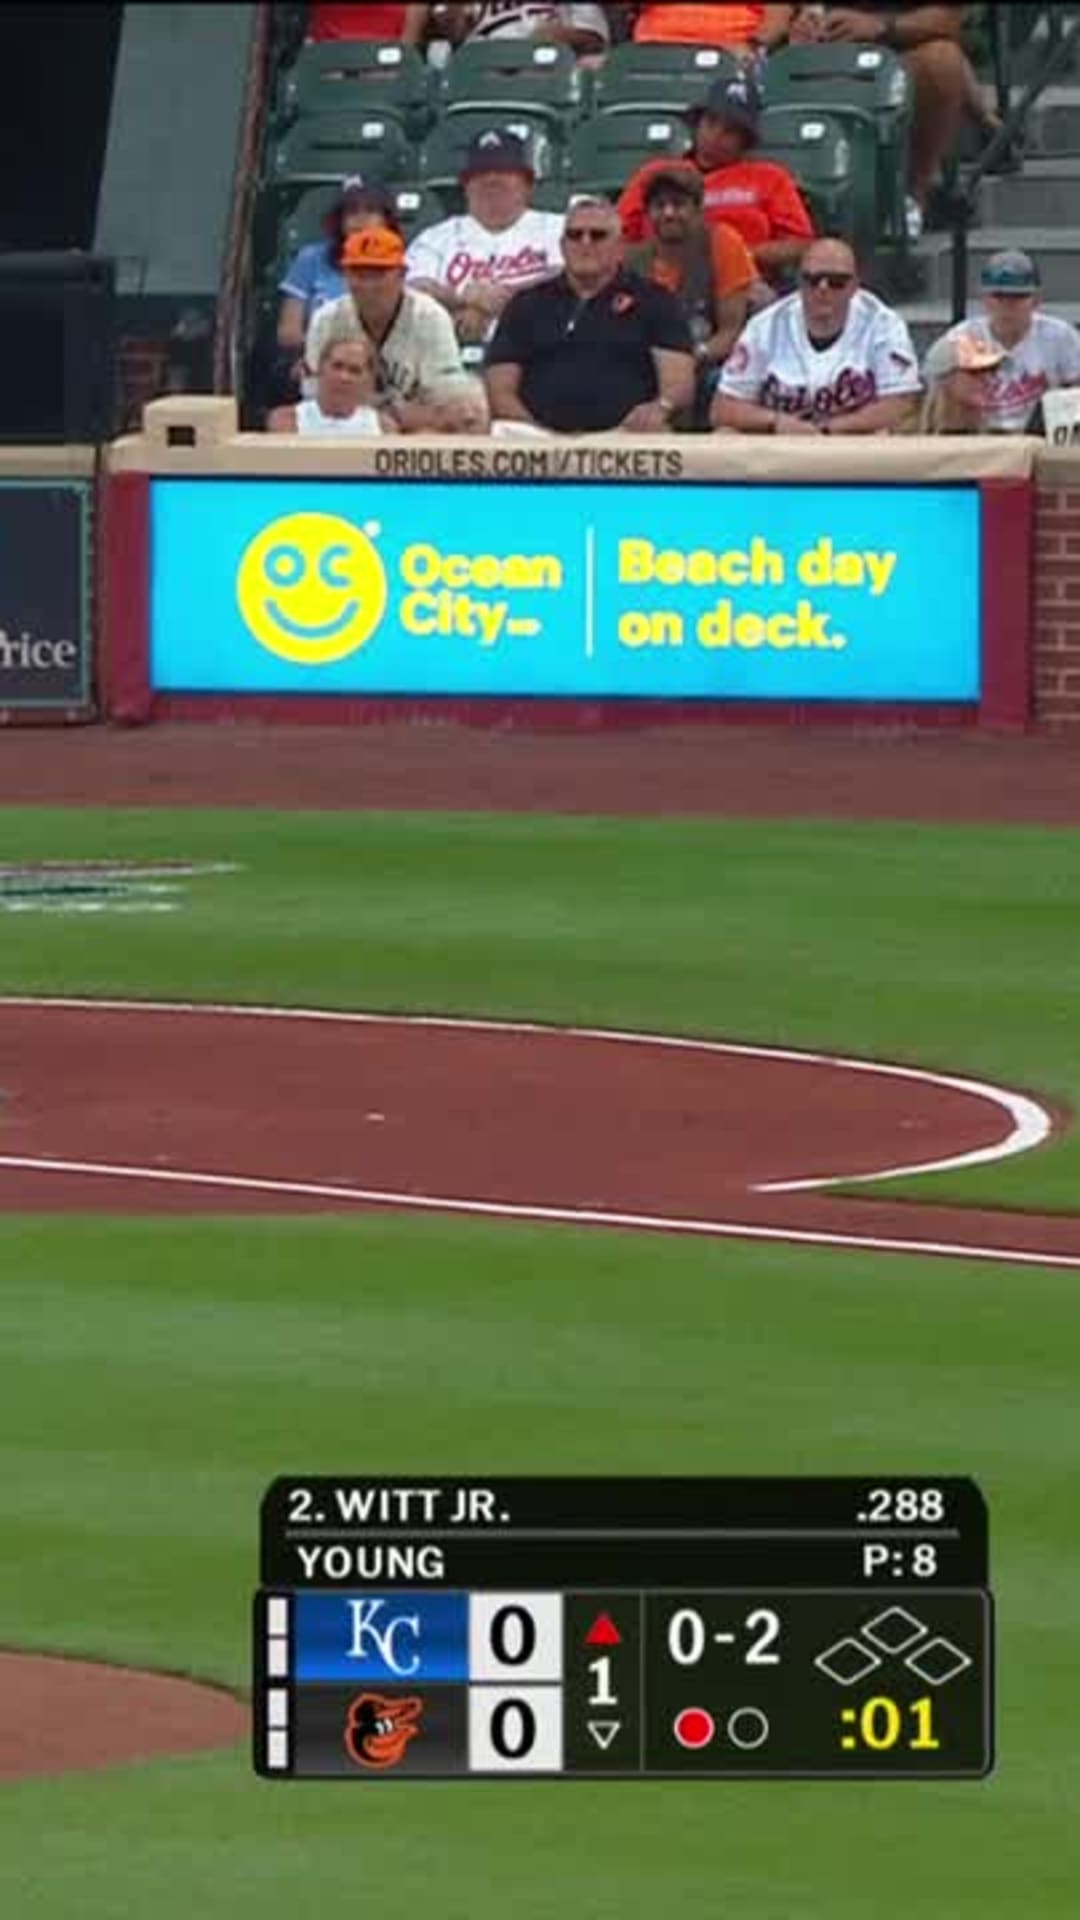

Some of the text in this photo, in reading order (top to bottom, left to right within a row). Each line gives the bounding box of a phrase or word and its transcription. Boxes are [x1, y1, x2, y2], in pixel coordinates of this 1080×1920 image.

[401, 545, 562, 588] Ocean
[618, 537, 897, 595] Beach day
[618, 598, 847, 647] on deck.
